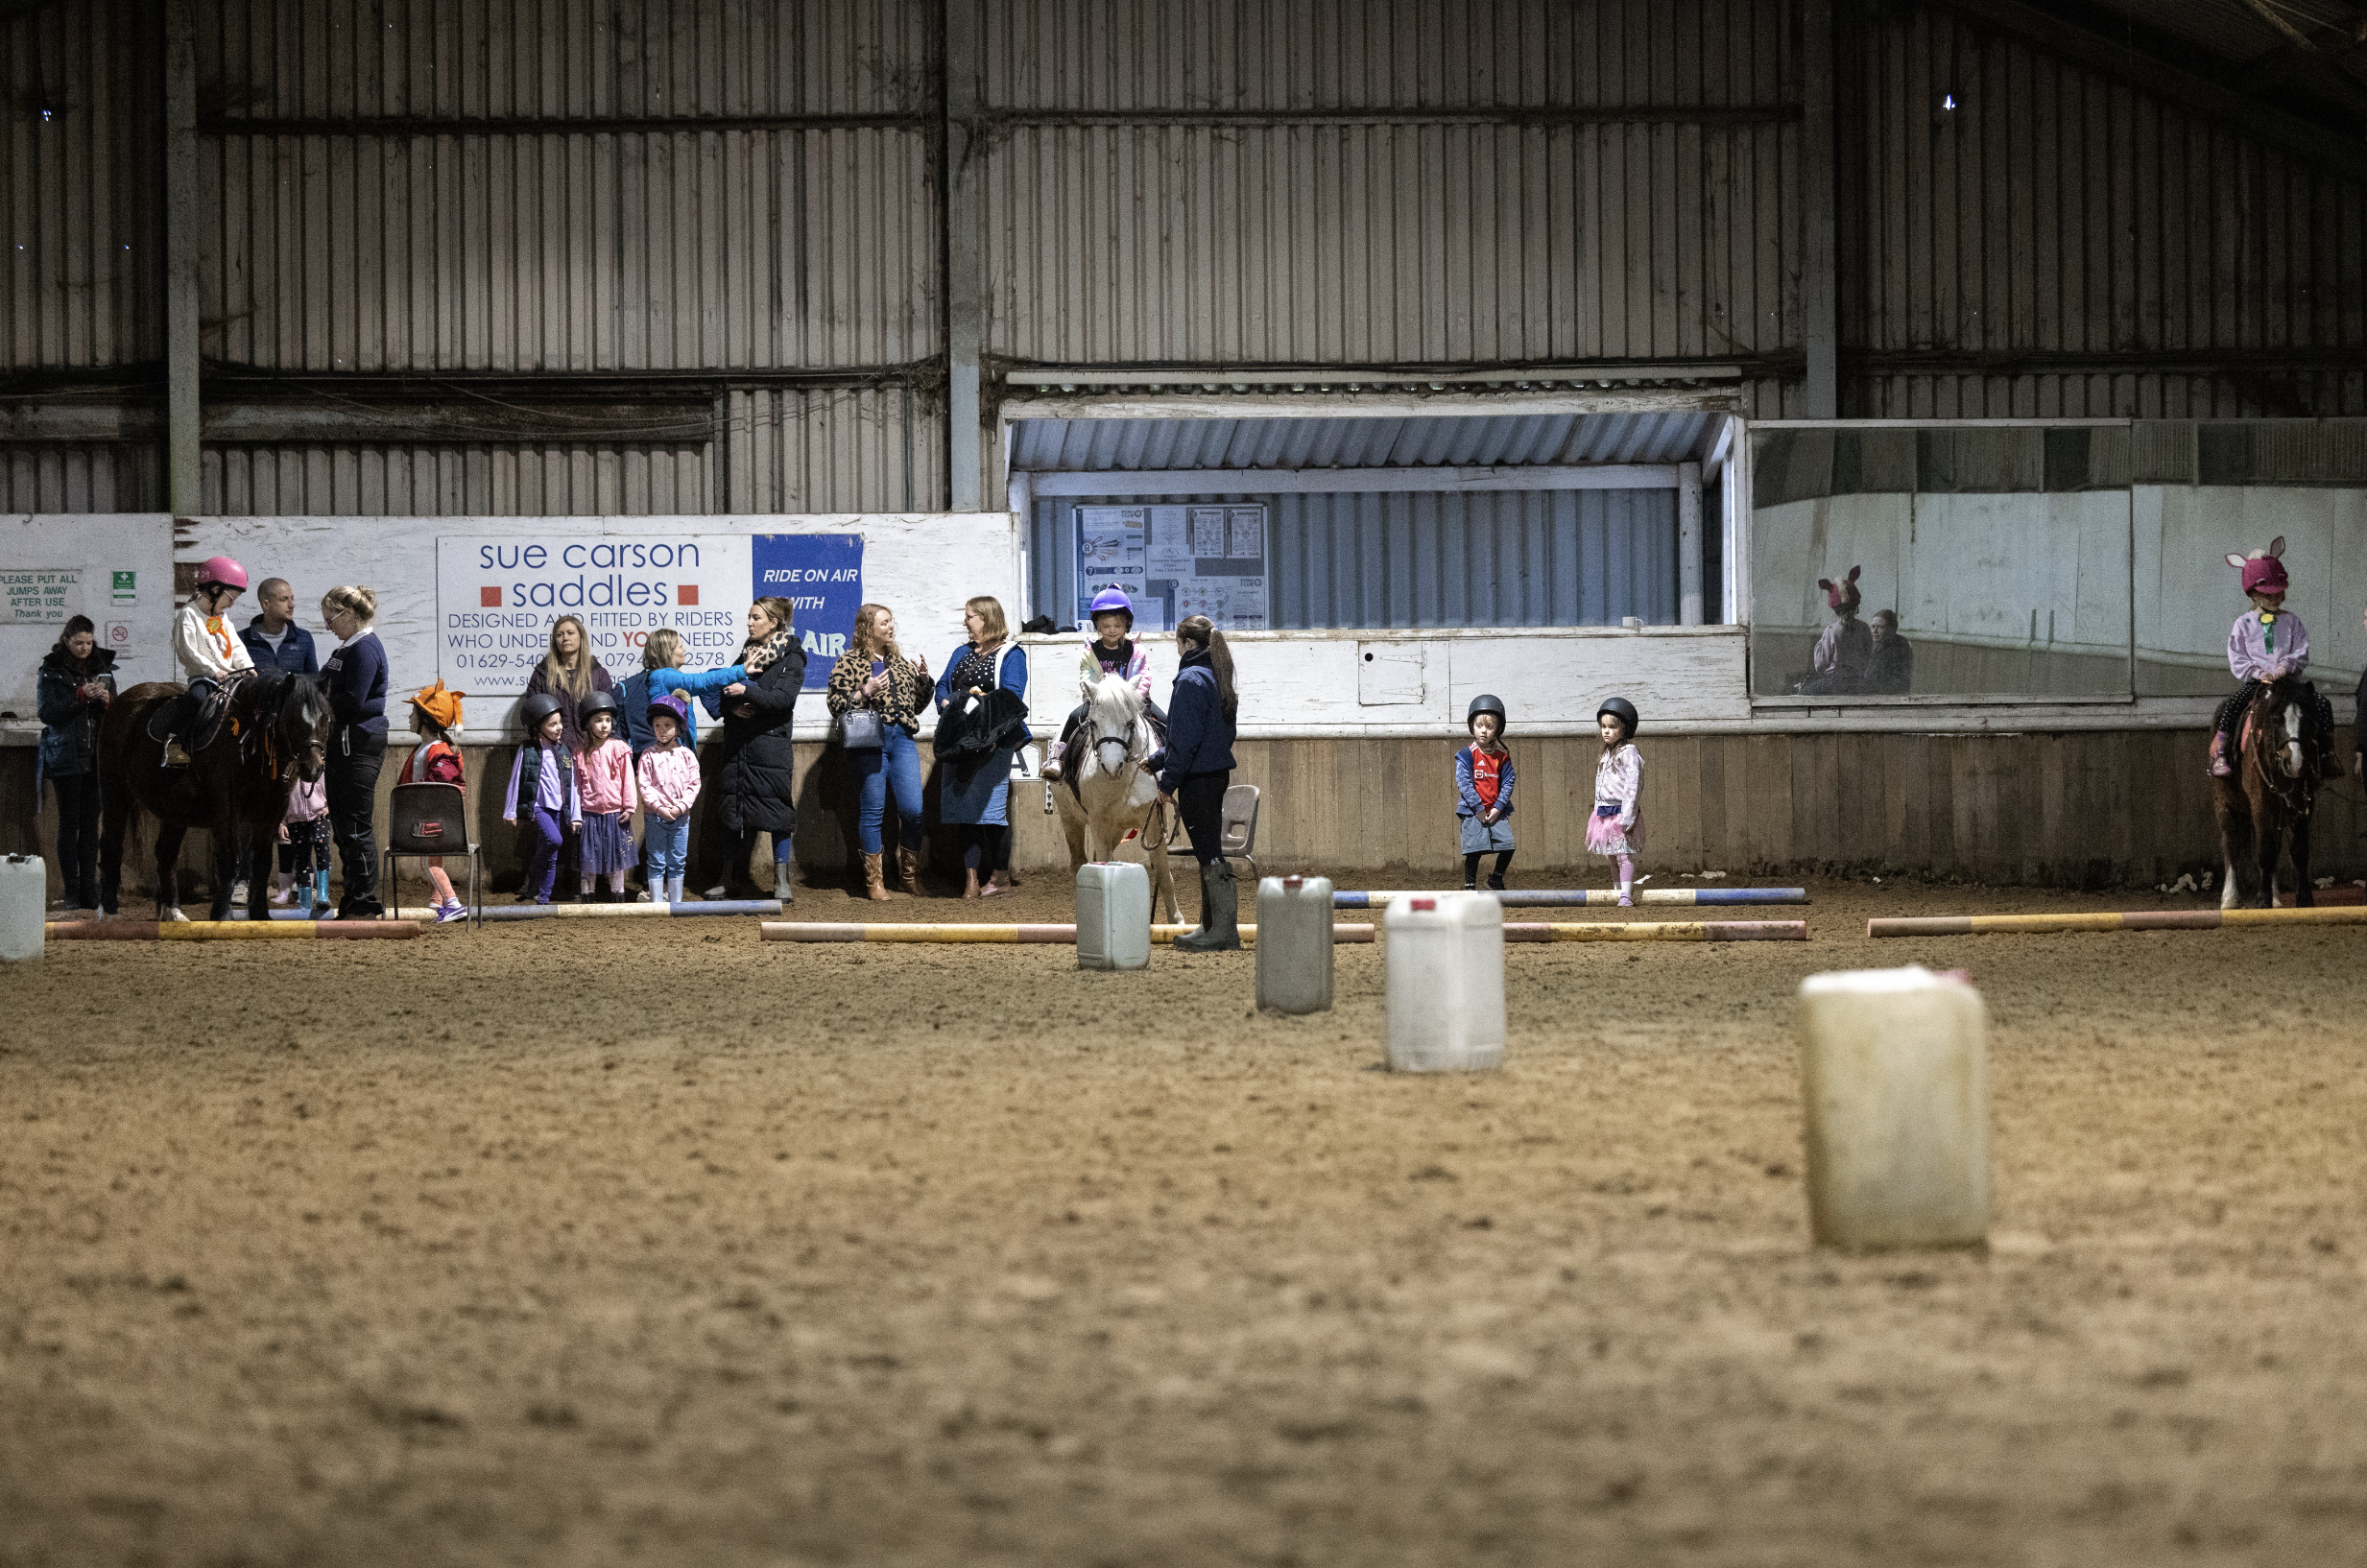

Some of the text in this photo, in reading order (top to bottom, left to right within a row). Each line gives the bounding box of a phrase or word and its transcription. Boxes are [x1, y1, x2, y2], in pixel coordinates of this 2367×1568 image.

[480, 543, 700, 569] sue carson
[37, 575, 57, 583] PUT
[60, 575, 78, 583] ALL
[763, 569, 859, 582] RIDE ON AIR
[7, 586, 68, 595] JUMPS AWAY
[513, 574, 668, 607] saddles
[11, 597, 65, 606] AFTER USE
[14, 608, 63, 619] Thank you
[448, 611, 733, 629] DESIGNED AD FITTED BY RIDERS
[447, 633, 493, 649] WHO
[622, 630, 650, 648] YO
[679, 631, 734, 648] NEEDS
